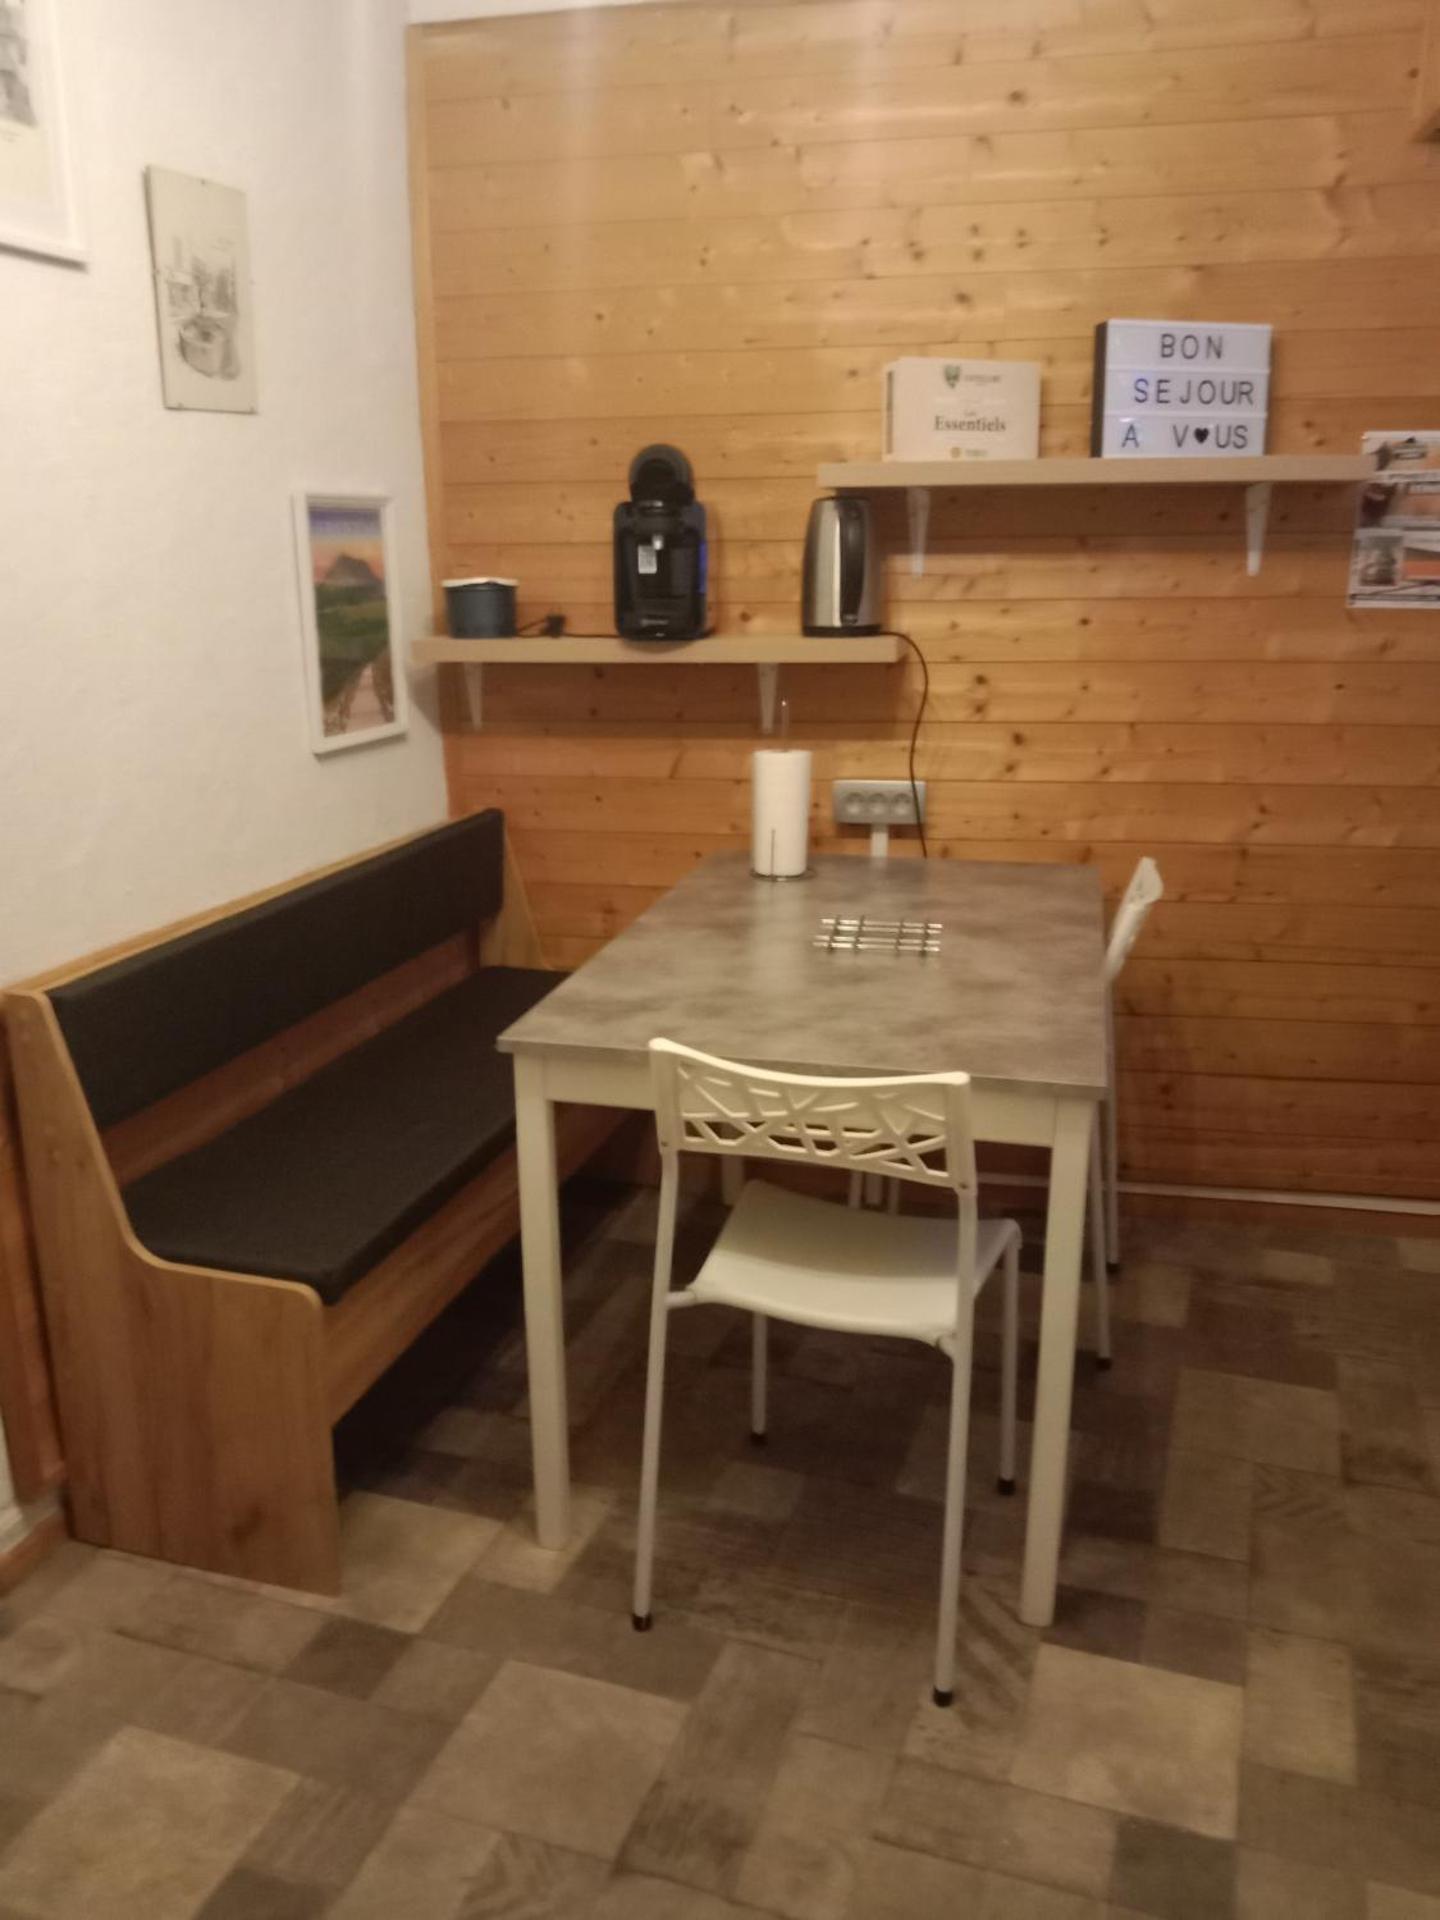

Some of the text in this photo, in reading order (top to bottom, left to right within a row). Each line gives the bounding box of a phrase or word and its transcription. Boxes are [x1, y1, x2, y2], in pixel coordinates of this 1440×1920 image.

[1161, 333, 1223, 360] BON
[1133, 378, 1254, 405] SEJOUR
[934, 415, 1006, 432] Essentiels
